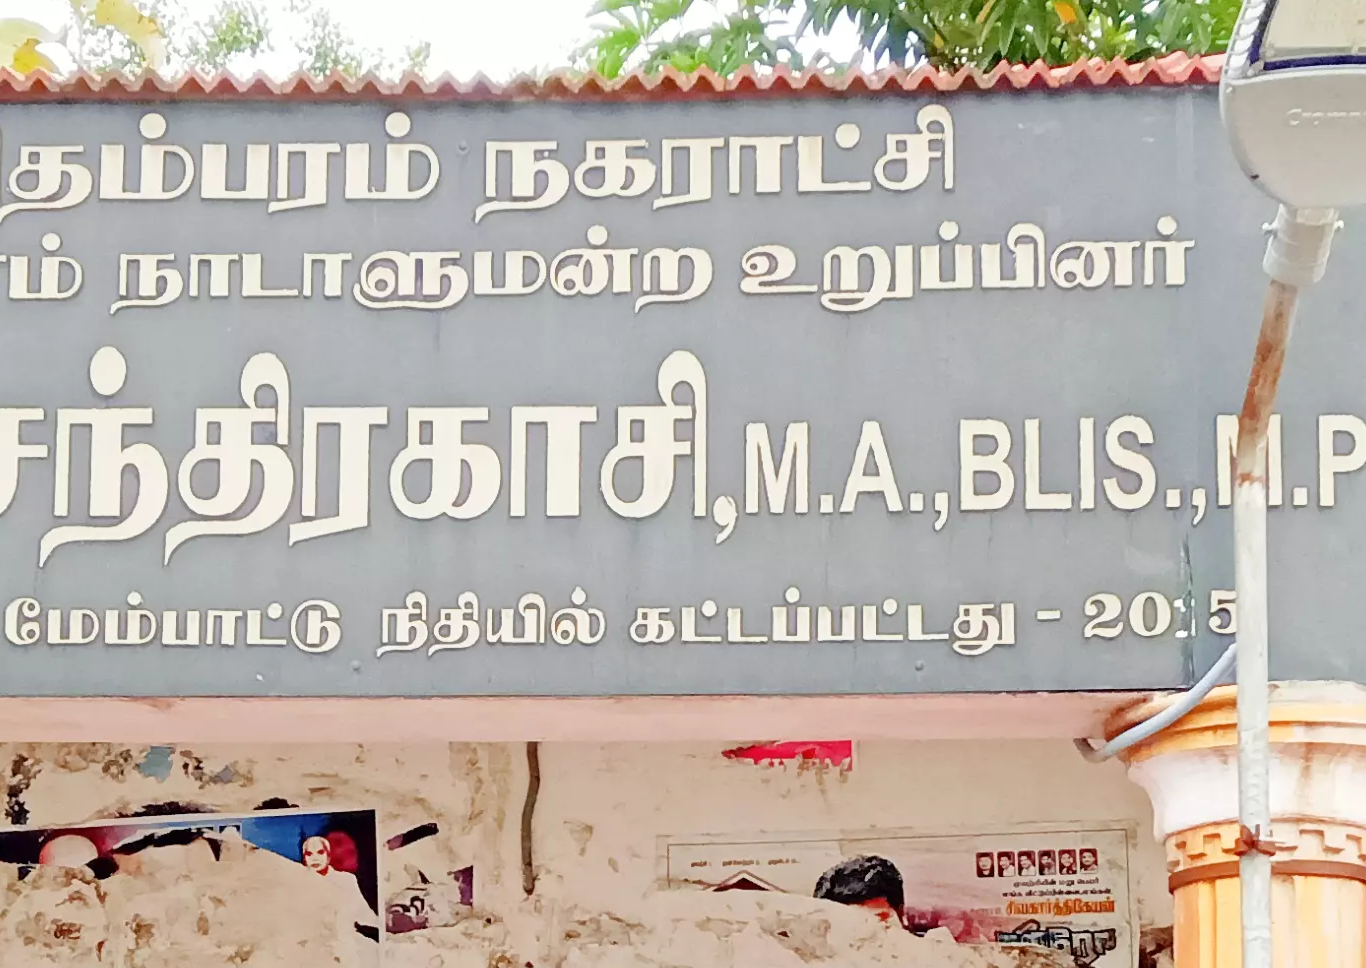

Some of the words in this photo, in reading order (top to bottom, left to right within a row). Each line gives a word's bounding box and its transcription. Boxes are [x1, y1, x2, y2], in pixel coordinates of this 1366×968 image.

[475, 103, 956, 222] நகராட்சி
[108, 224, 714, 315] நாடாளுமன்ற
[738, 214, 1195, 314] உறுப்பினர்
[3, 588, 341, 654] மேம்பாட்டு
[375, 587, 607, 657] நிதியில்
[628, 586, 1016, 657] கட்டப்பட்டது
